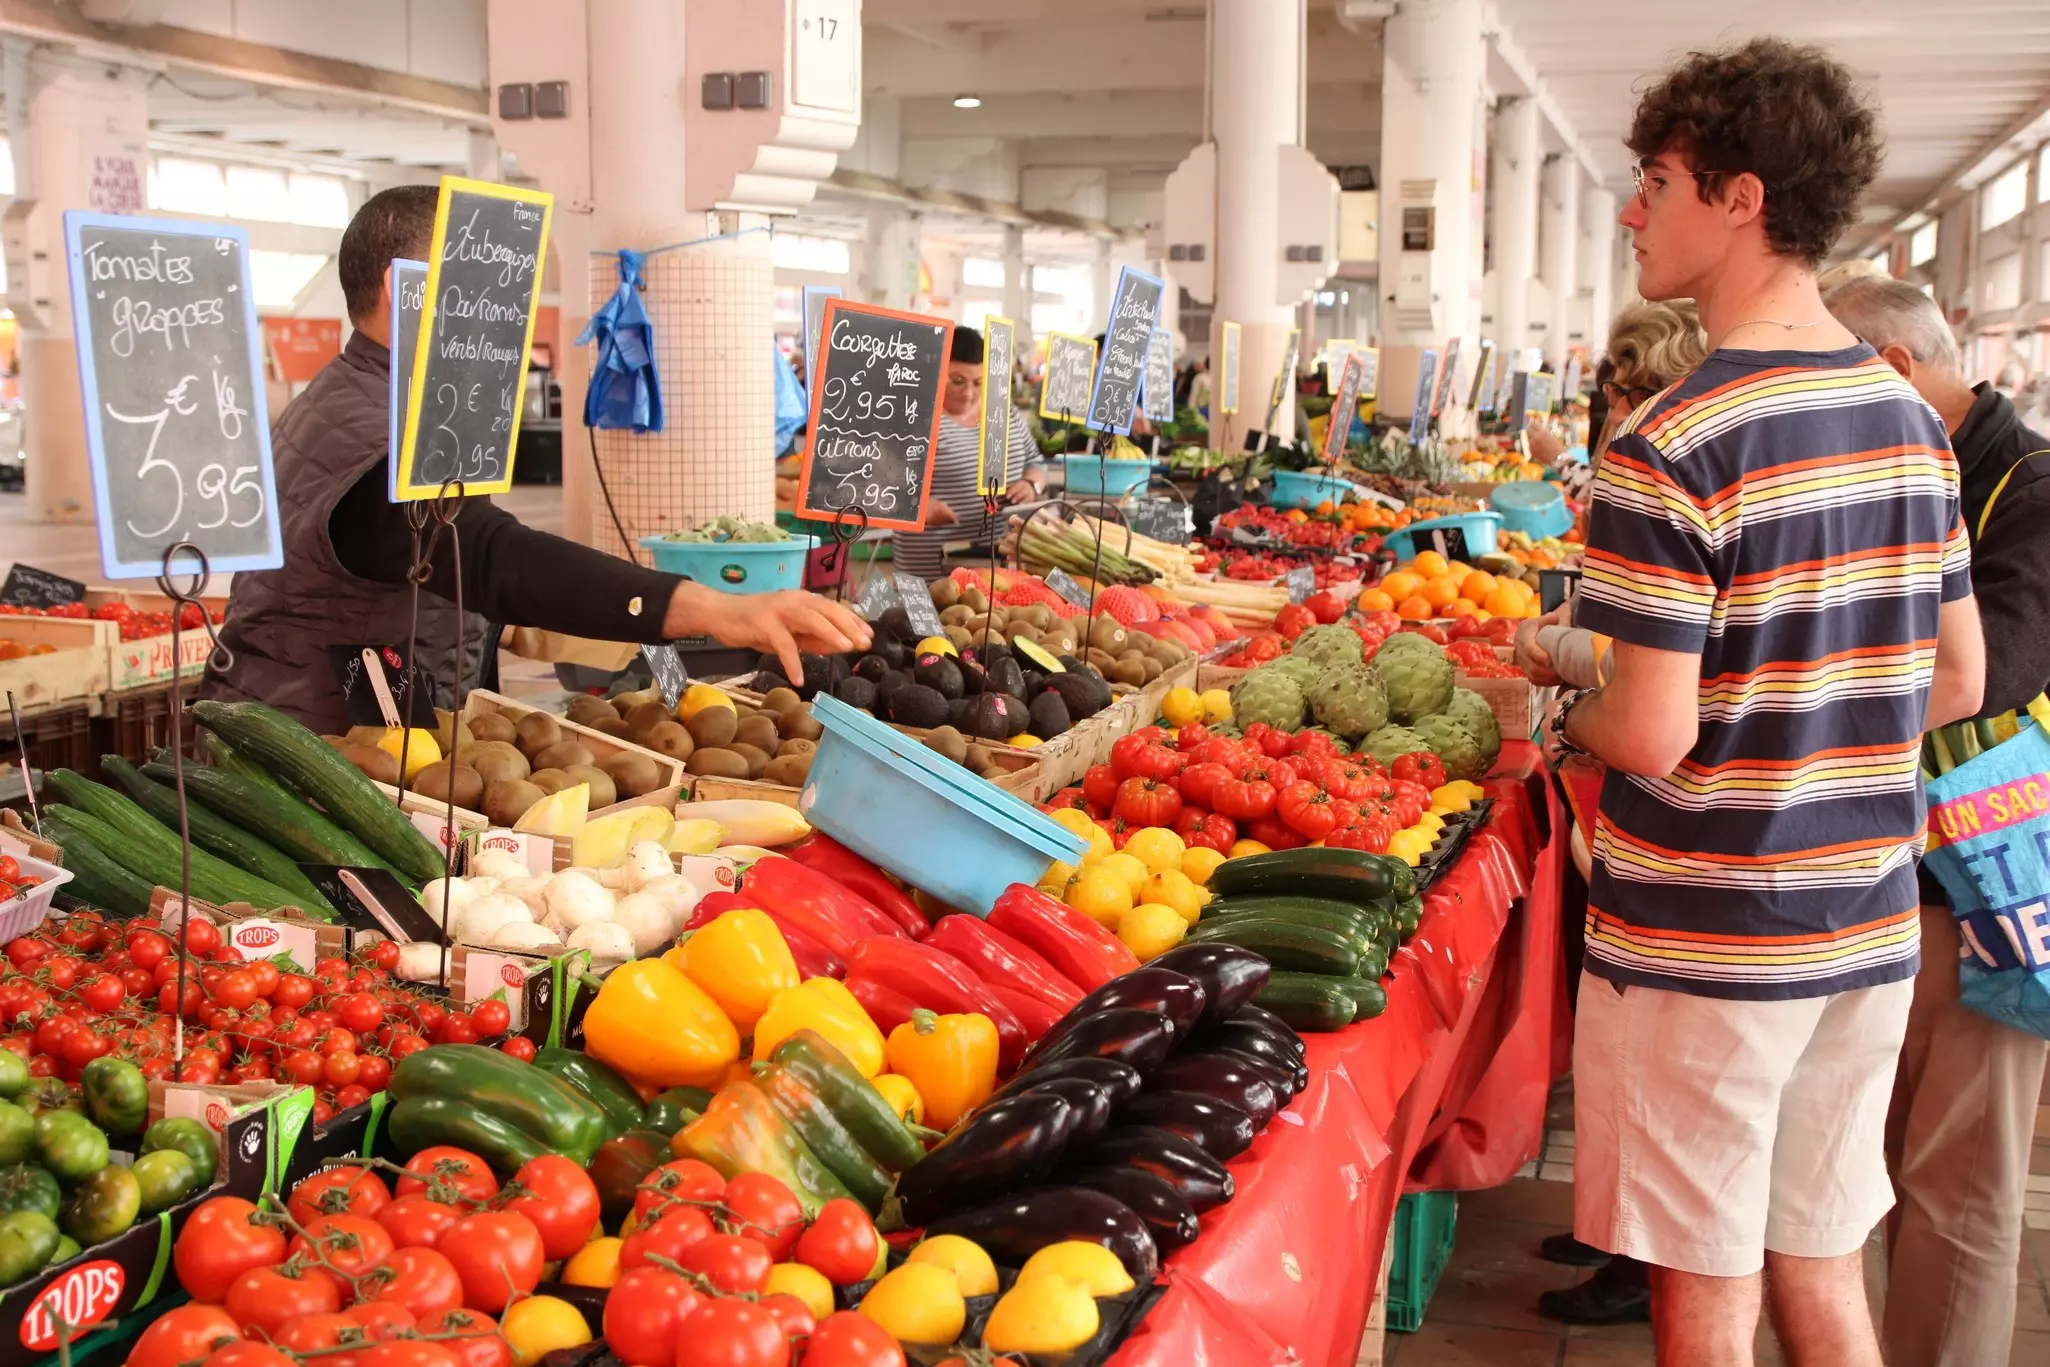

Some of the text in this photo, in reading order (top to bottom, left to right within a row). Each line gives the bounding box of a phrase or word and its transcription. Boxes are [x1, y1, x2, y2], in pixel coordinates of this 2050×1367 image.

[818, 16, 838, 40] 17
[513, 201, 541, 222] France
[1936, 781, 2049, 839] UN SAC
[237, 927, 279, 945] TROPS
[25, 1264, 121, 1346] TROPS
